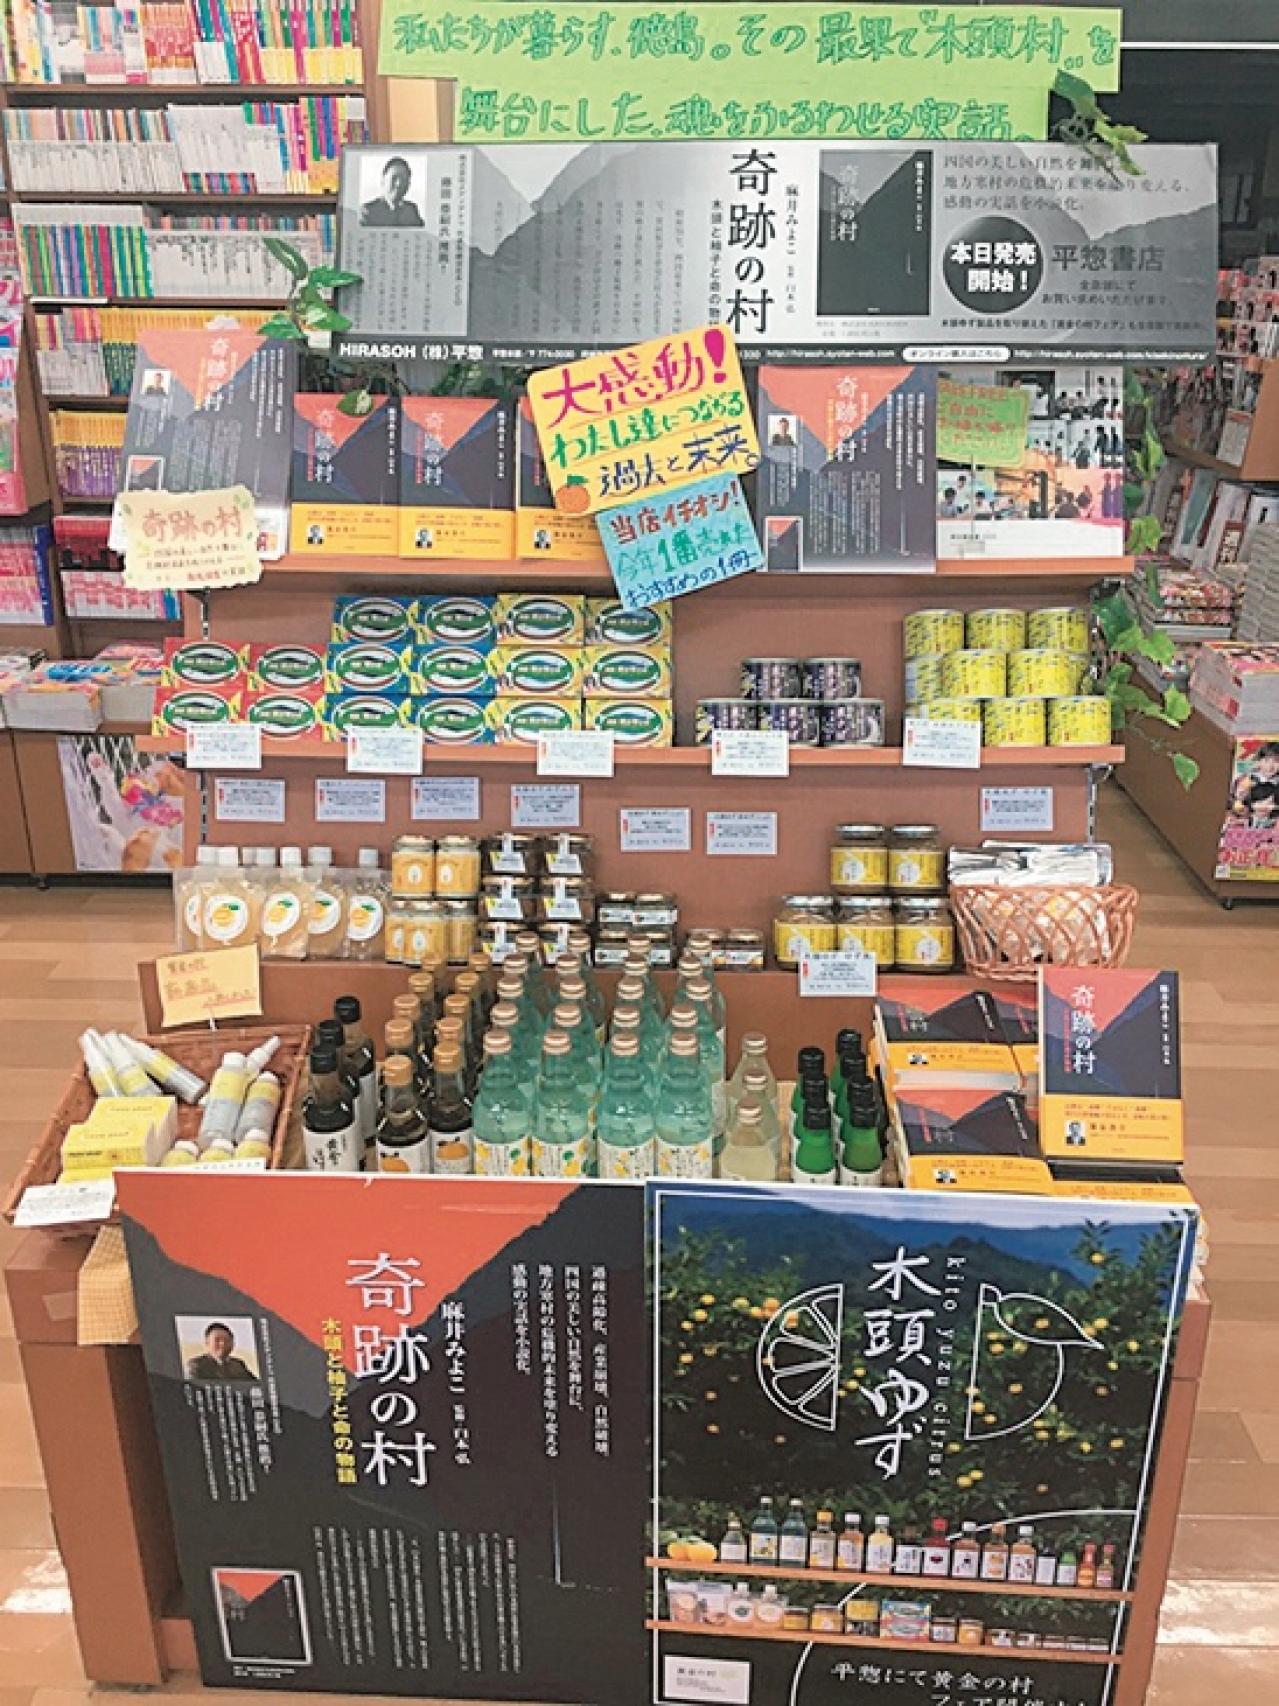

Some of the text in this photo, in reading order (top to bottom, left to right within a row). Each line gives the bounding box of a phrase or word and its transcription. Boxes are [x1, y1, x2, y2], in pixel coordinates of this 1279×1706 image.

[727, 148, 778, 335] 奇跡の村
[950, 240, 1037, 266] 本日発売
[1052, 244, 1165, 272] 平惣書店
[340, 343, 416, 359] HIRASOH
[142, 505, 244, 542] 奇跡の村
[1072, 985, 1096, 1075] 奇跡の村
[346, 1253, 437, 1486] 奇跡の村
[855, 1246, 941, 1480] 木頭ゆず
[928, 1257, 966, 1477] kito yuzu citrus
[831, 1661, 1034, 1695] 平惣にて黄金の村
